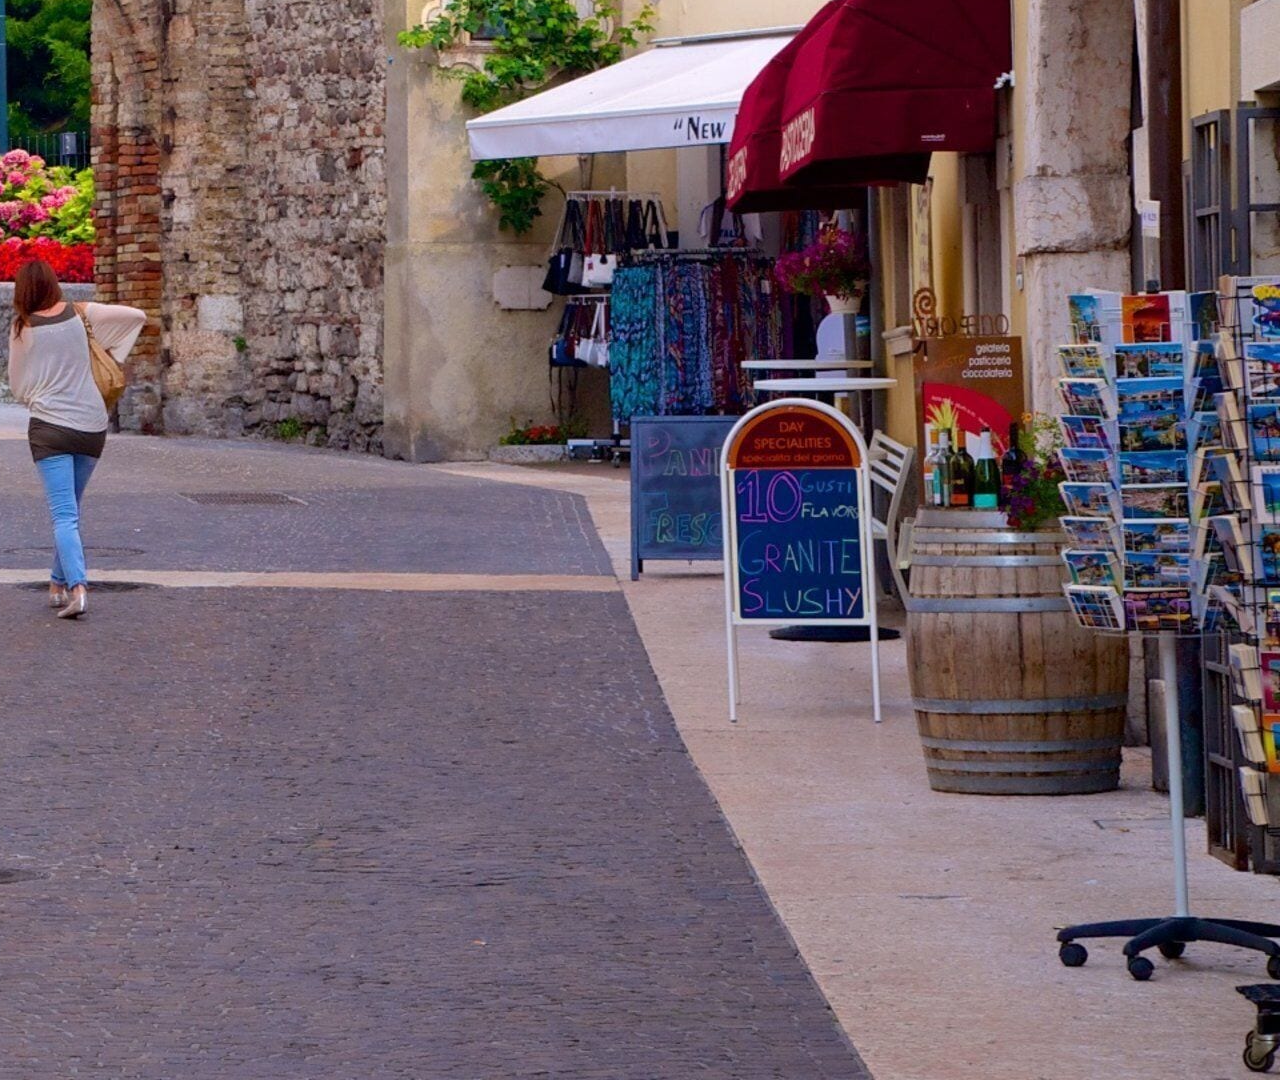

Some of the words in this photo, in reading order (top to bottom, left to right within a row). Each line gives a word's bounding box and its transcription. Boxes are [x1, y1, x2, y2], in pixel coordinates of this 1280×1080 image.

[975, 344, 1010, 356] gelateria
[968, 356, 1012, 368] pasticceria
[961, 368, 1013, 379] cioccolateria
[779, 421, 805, 433] DAY
[753, 437, 832, 450] SPECIALITIES
[743, 578, 861, 616] SLUSHY
